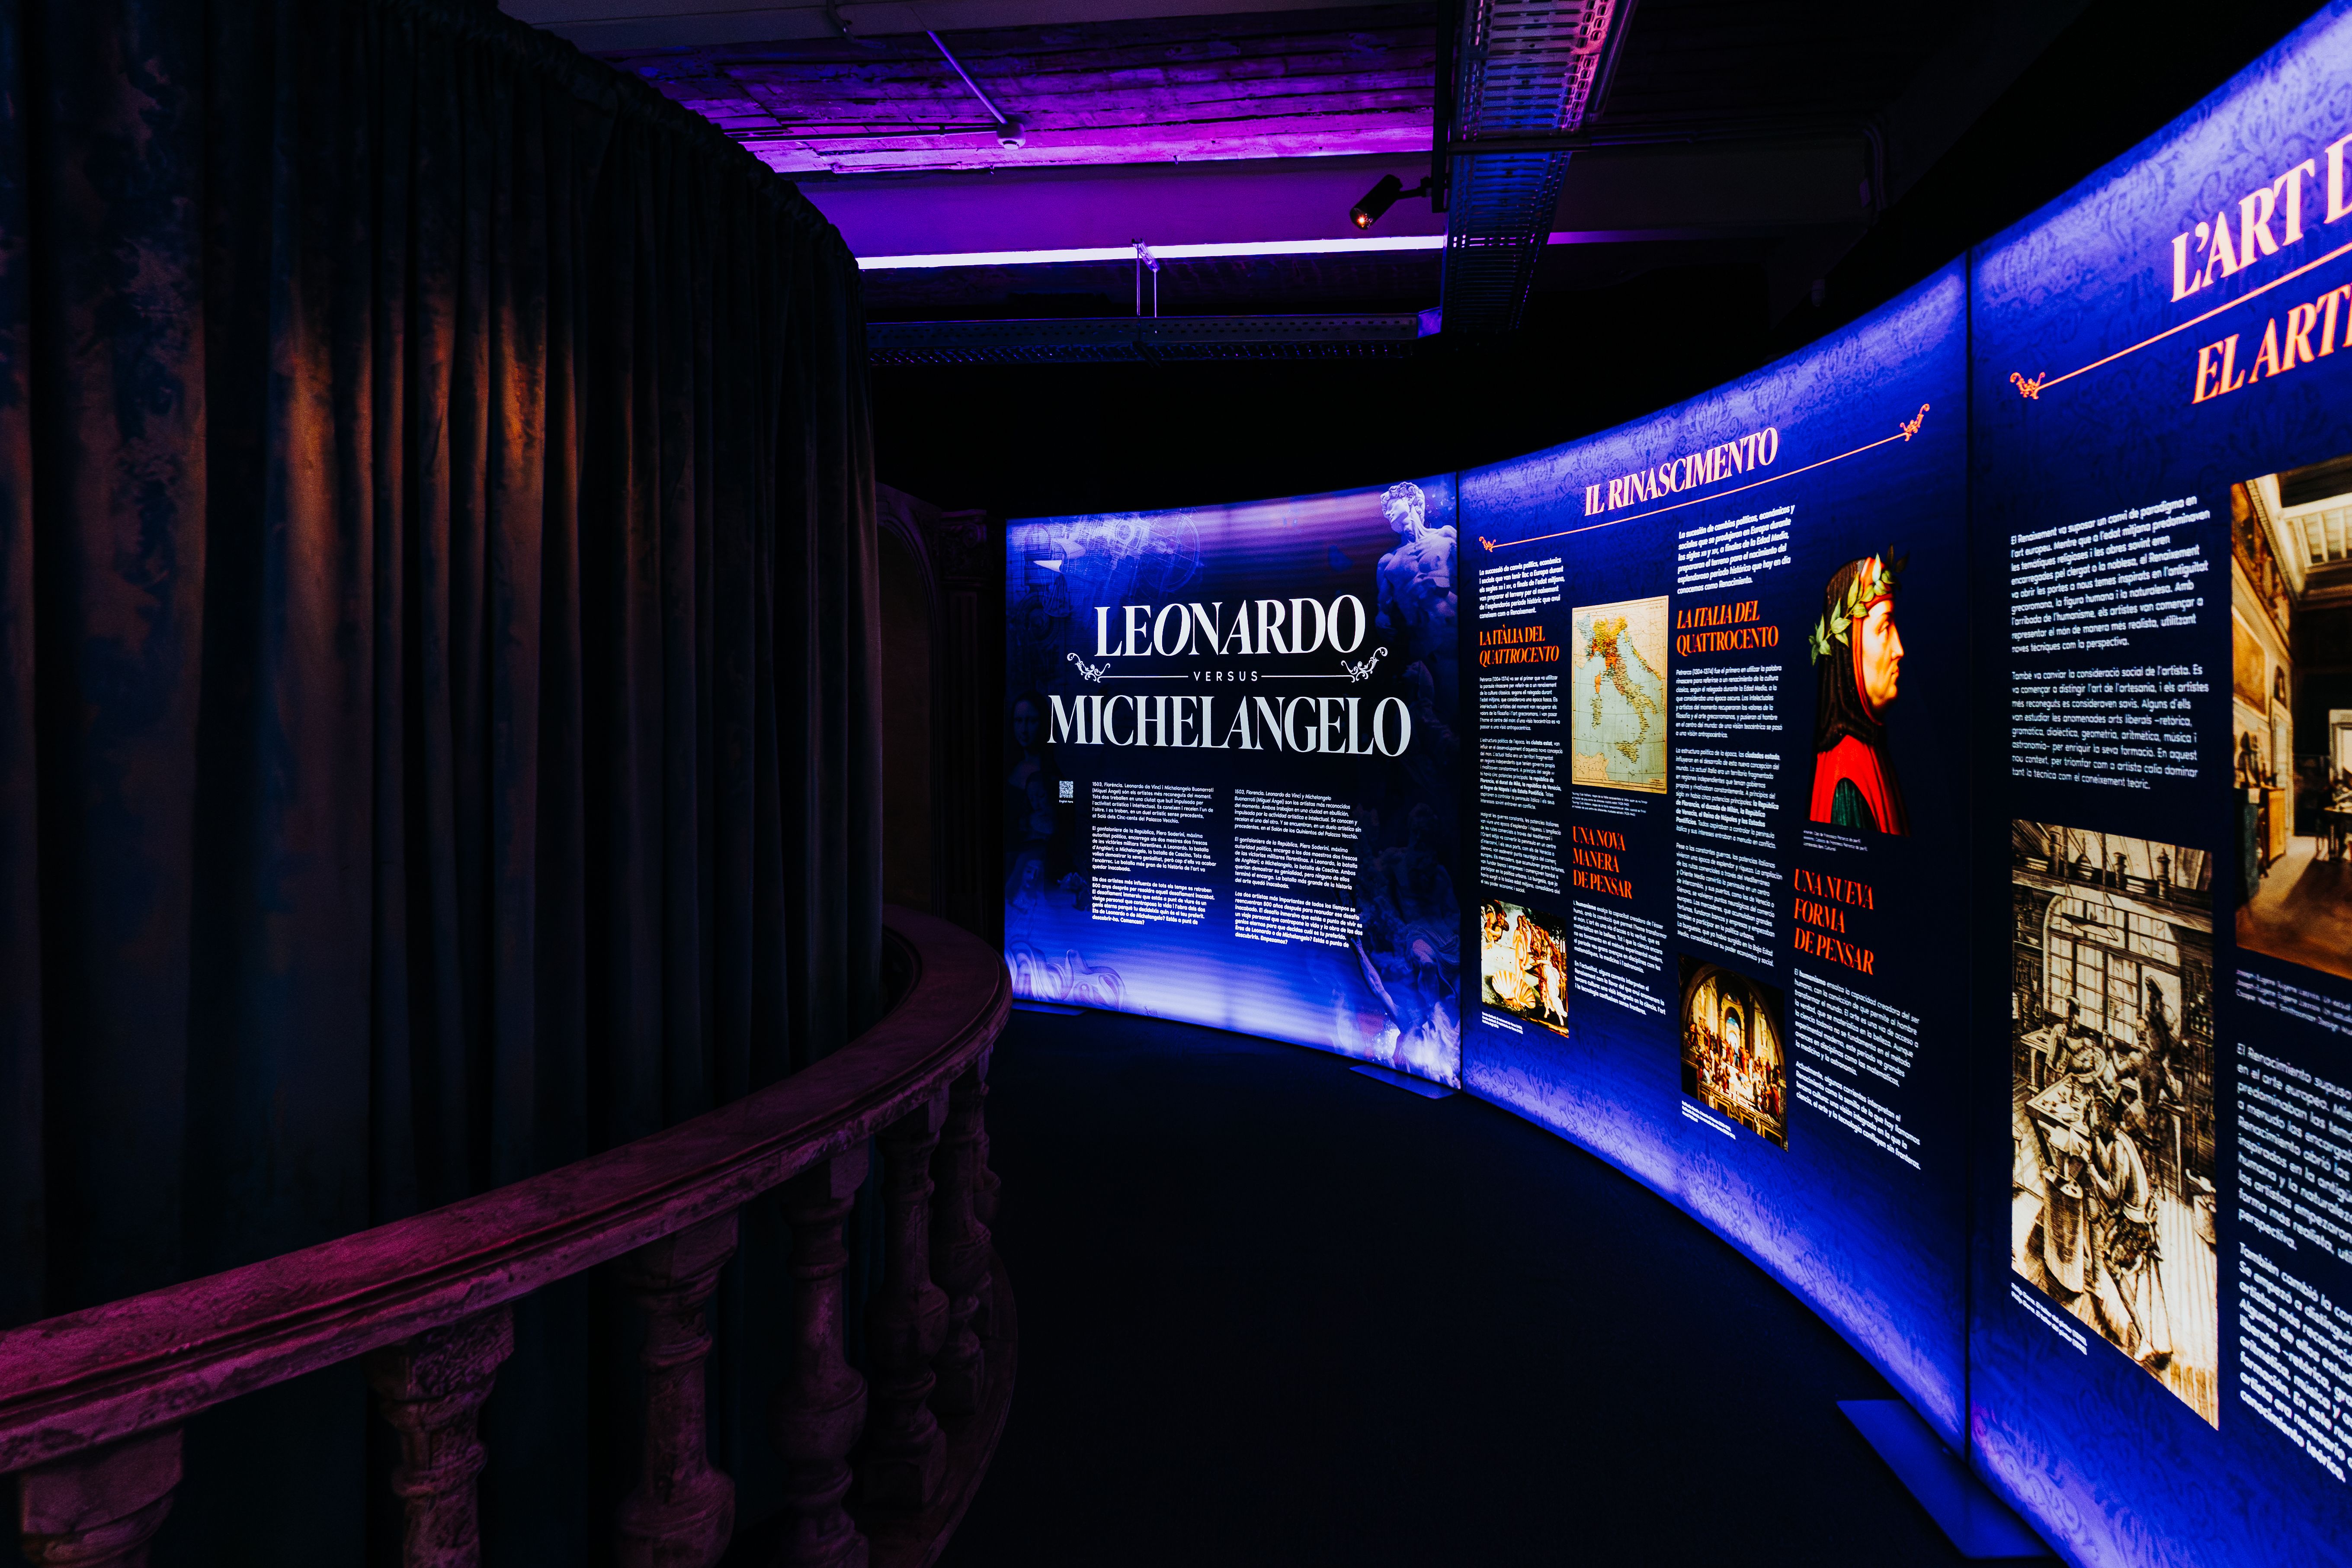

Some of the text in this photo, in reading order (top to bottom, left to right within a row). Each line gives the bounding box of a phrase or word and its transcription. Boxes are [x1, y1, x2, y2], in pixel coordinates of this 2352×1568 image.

[2192, 333, 2246, 404] EL
[1585, 426, 1778, 516] IL RINASCIMENTO
[1094, 595, 1365, 656] LEONARDO
[1677, 600, 1760, 629] LA ITALIA DEL
[1480, 624, 1545, 646] LA ITÀLIA DEL
[1676, 625, 1778, 657] QUATTROCENTO
[1480, 645, 1559, 667] QUATTROCENTO
[1193, 670, 1257, 682] VERSUS
[1047, 695, 1411, 756] MICHELANGELO
[1305, 794, 1331, 802] Michelangelo
[1573, 825, 1626, 851] UNA NOVA
[1573, 847, 1620, 873] MANERA
[1573, 869, 1632, 899] DE PENSAR
[1794, 869, 1874, 910] UNA NUEVA
[1794, 898, 1845, 933] FORMA
[1794, 927, 1874, 975] DE PENSAR
